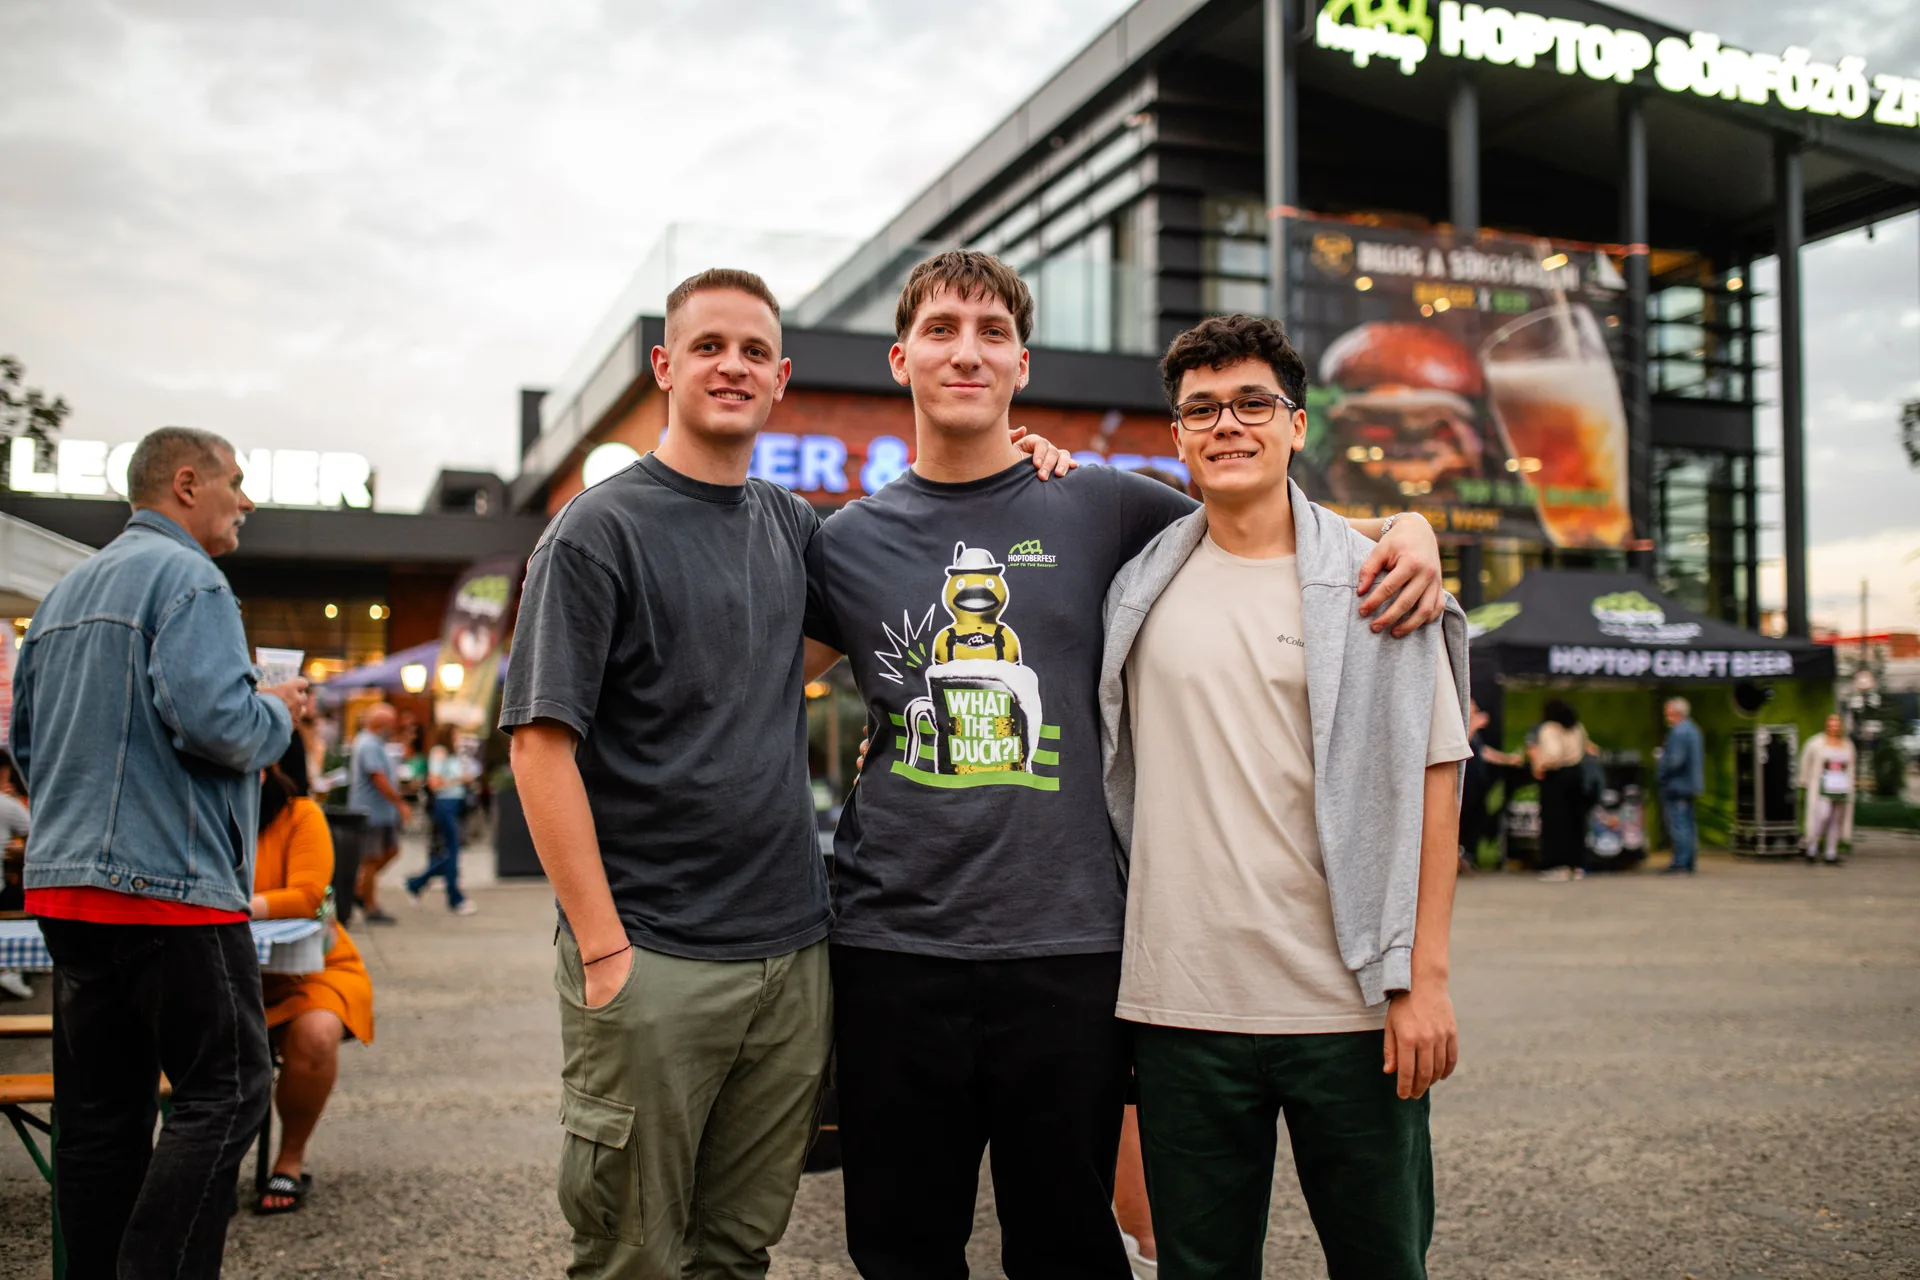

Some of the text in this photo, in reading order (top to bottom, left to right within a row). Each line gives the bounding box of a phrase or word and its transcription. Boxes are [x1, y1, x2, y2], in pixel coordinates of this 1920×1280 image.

[1438, 0, 1653, 84] HOPTOP
[10, 436, 373, 509] LENER
[1008, 554, 1056, 563] HOPTOBERFEST
[1550, 645, 1793, 678] HOPTOP CRAFT BEER
[947, 691, 1008, 716] WHAT
[962, 714, 994, 740] THE
[951, 737, 1019, 765] DUCK?!
